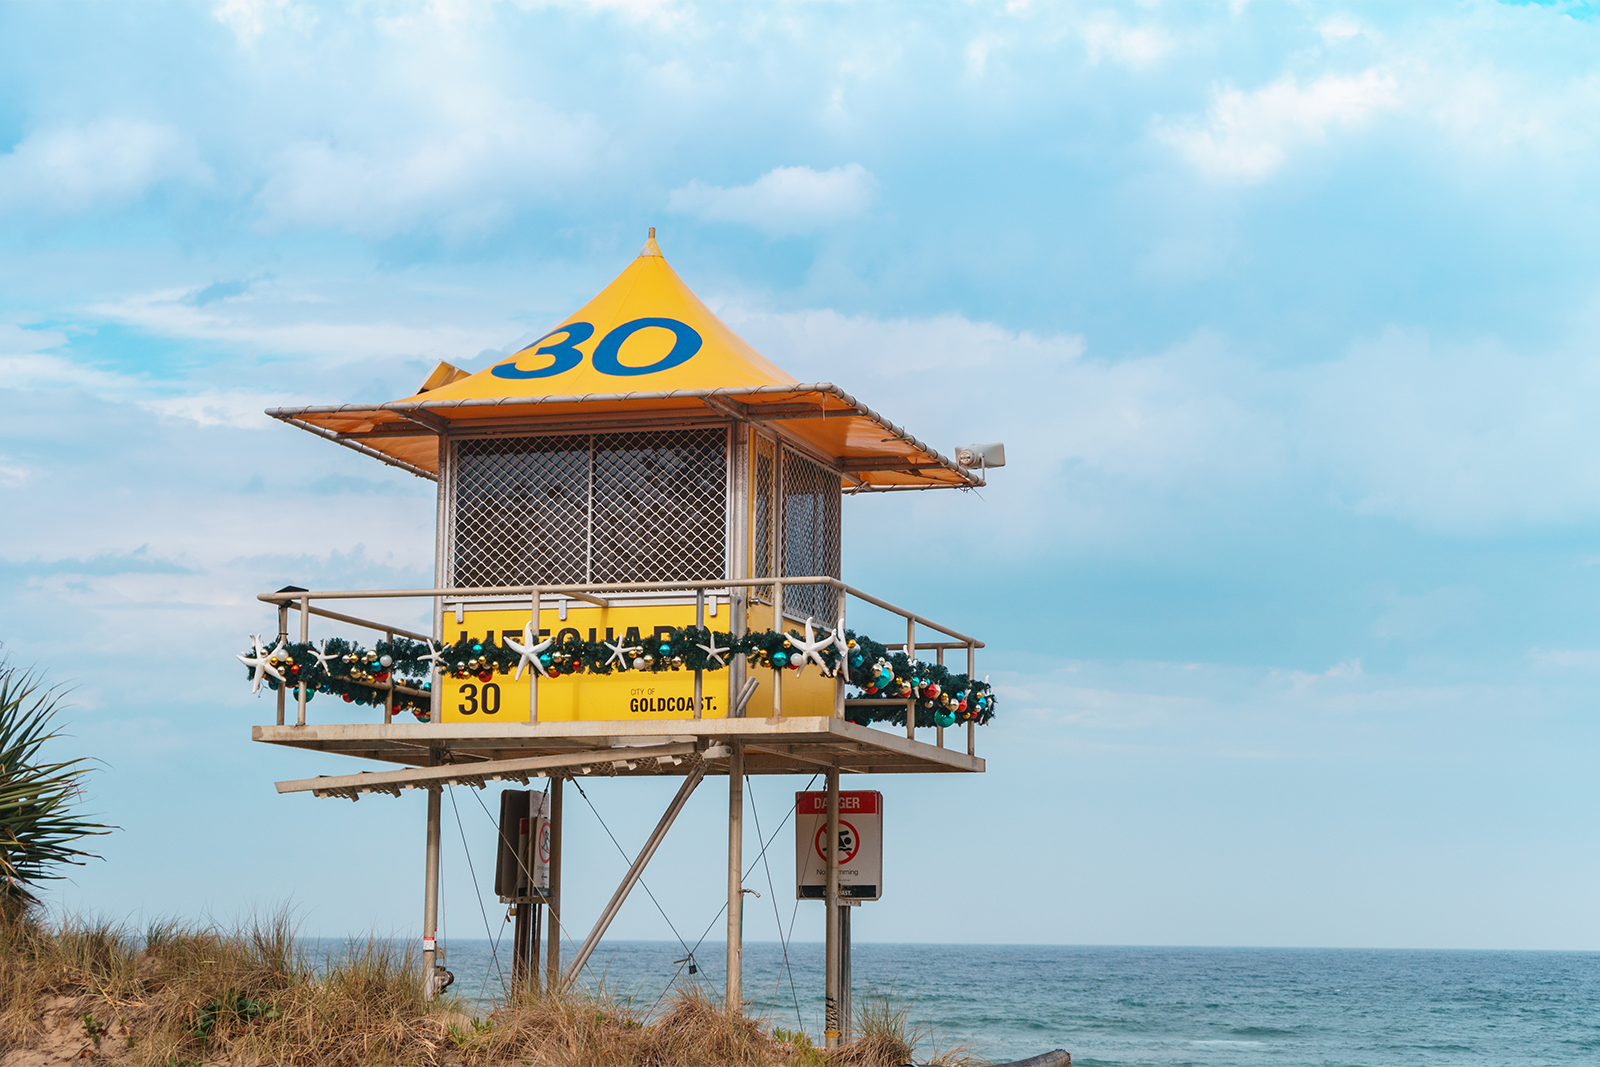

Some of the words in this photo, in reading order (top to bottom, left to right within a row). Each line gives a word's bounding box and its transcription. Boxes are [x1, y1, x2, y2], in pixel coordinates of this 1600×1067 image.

[491, 316, 703, 379] 30
[458, 683, 501, 715] 30
[630, 688, 645, 696] CITY
[814, 797, 860, 809] DAGER
